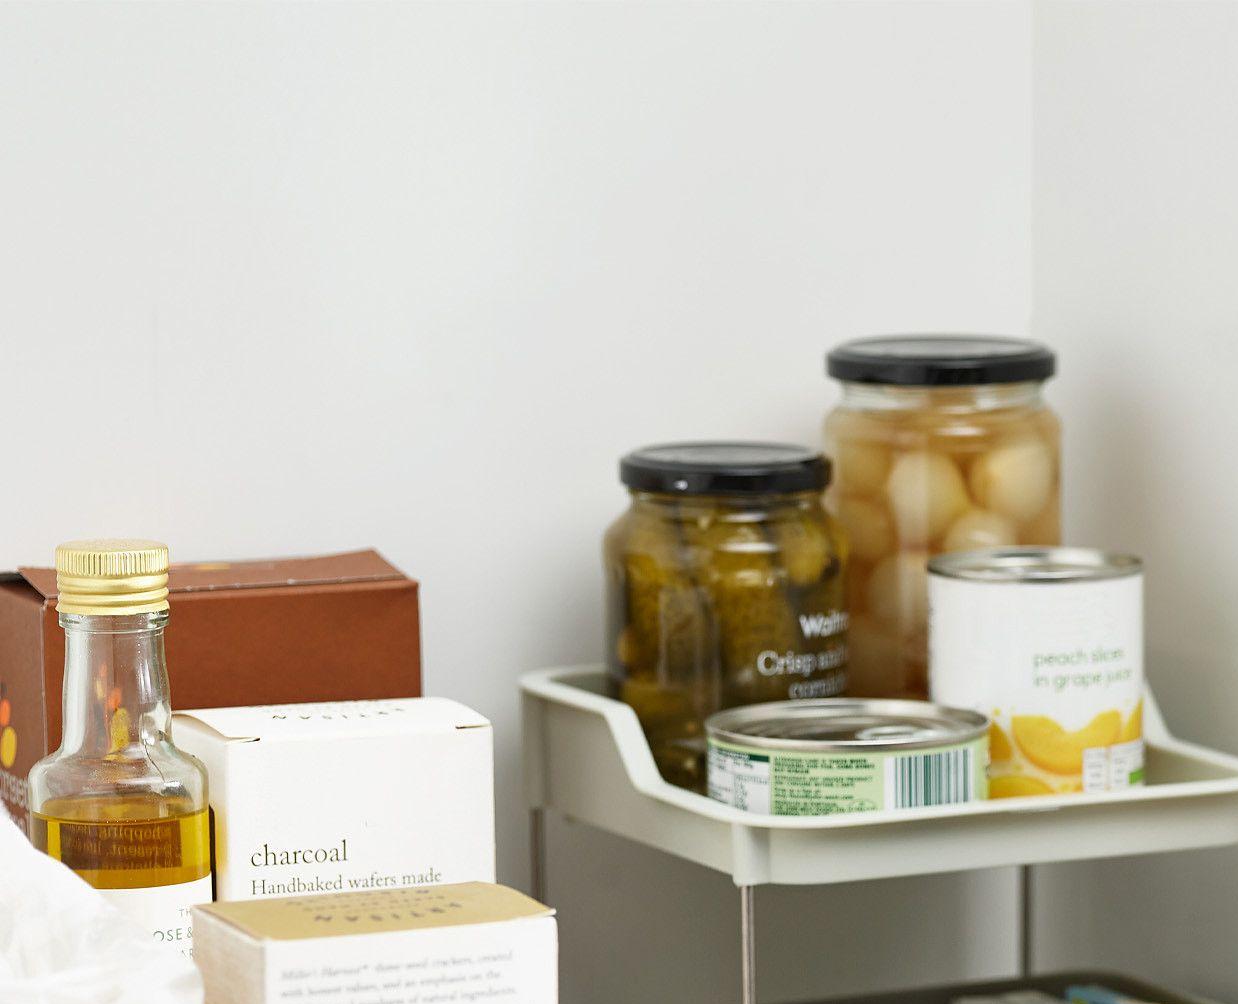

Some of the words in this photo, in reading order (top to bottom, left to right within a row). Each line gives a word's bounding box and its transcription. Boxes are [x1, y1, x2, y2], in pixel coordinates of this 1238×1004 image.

[757, 650, 816, 677] Crisp
[1034, 649, 1087, 669] peach
[1034, 674, 1049, 688] in
[1053, 672, 1102, 693] grape
[251, 839, 348, 868] charcoal
[251, 874, 343, 896] Handbaked
[349, 871, 396, 890] wafers
[403, 867, 442, 884] made
